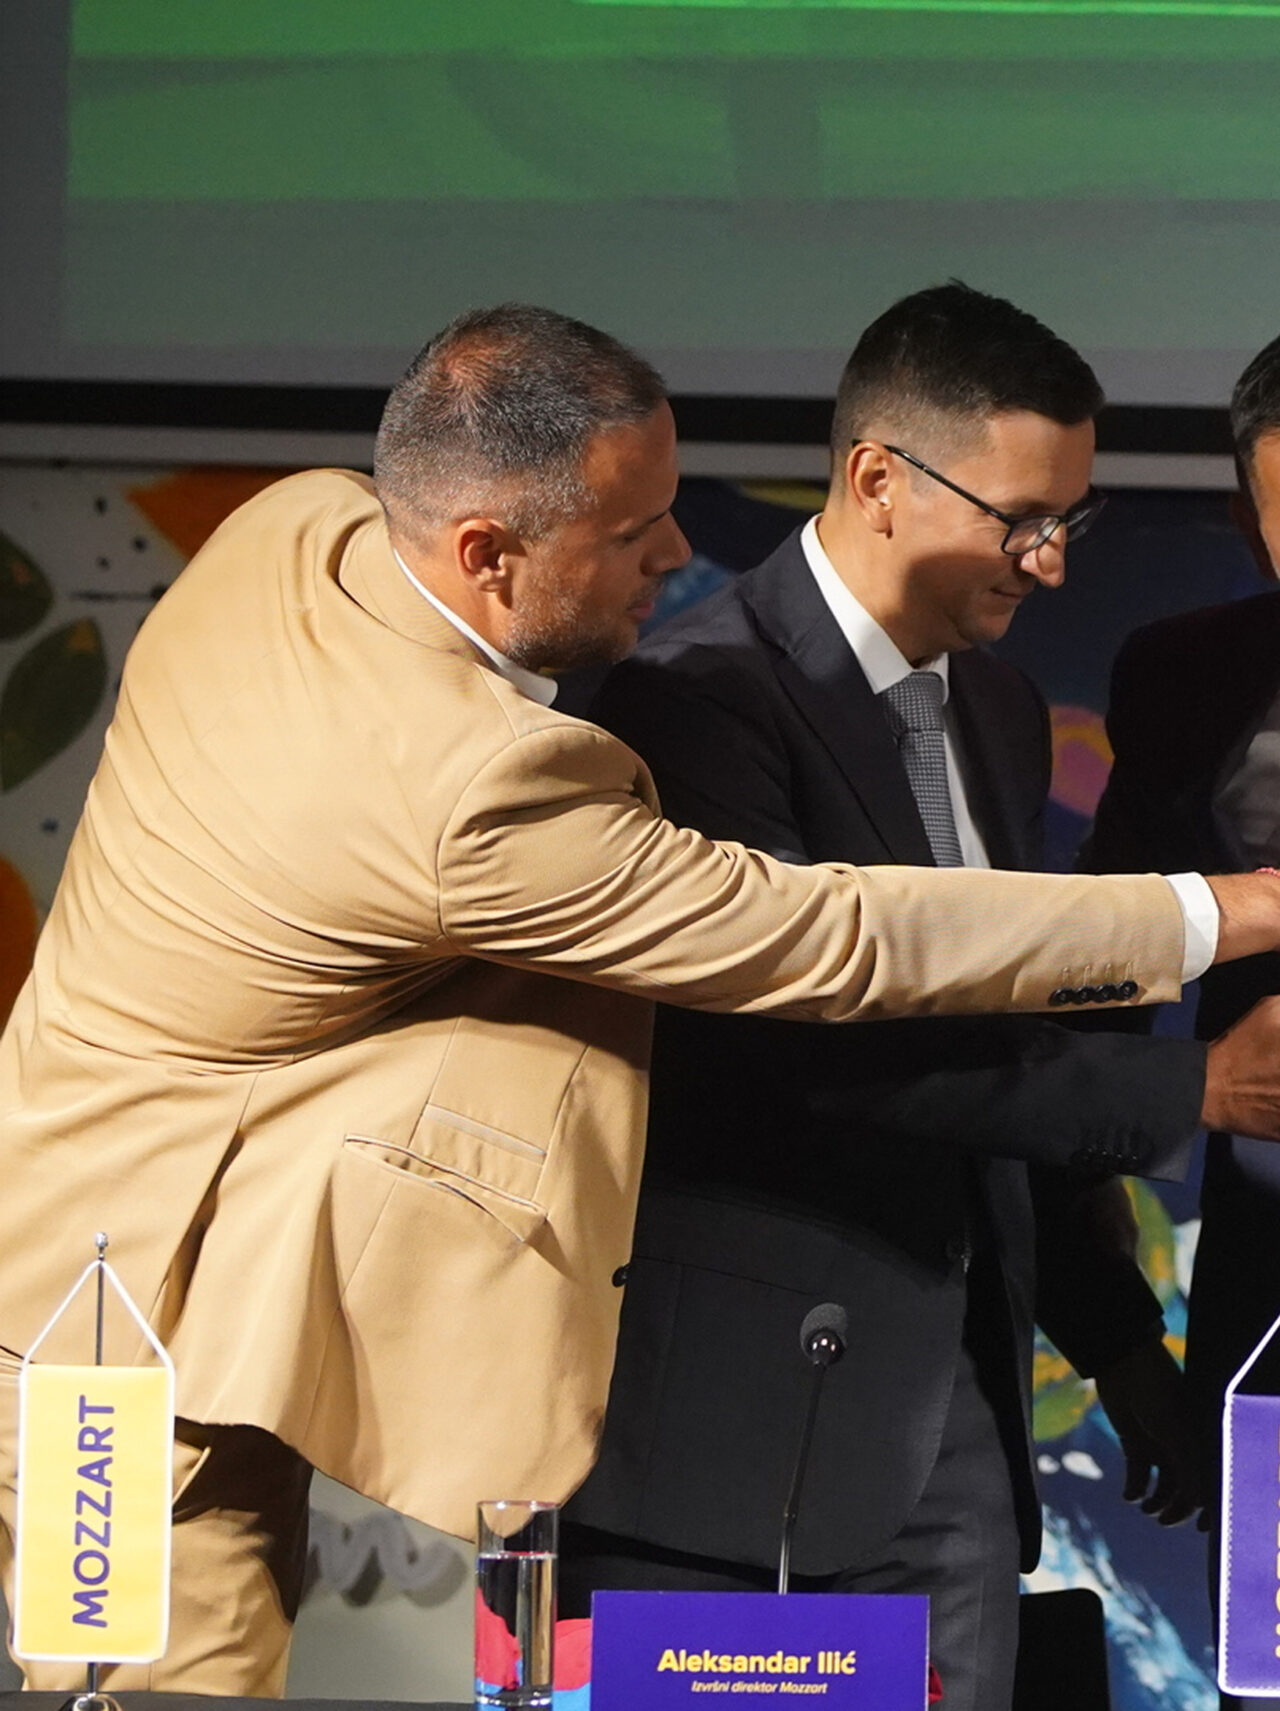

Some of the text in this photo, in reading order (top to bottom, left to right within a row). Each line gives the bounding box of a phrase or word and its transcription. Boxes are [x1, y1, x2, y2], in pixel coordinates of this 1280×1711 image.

[72, 1395, 114, 1628] MOZZART
[657, 1648, 857, 1675] Aleksandar Ilić
[730, 1680, 778, 1694] direktor
